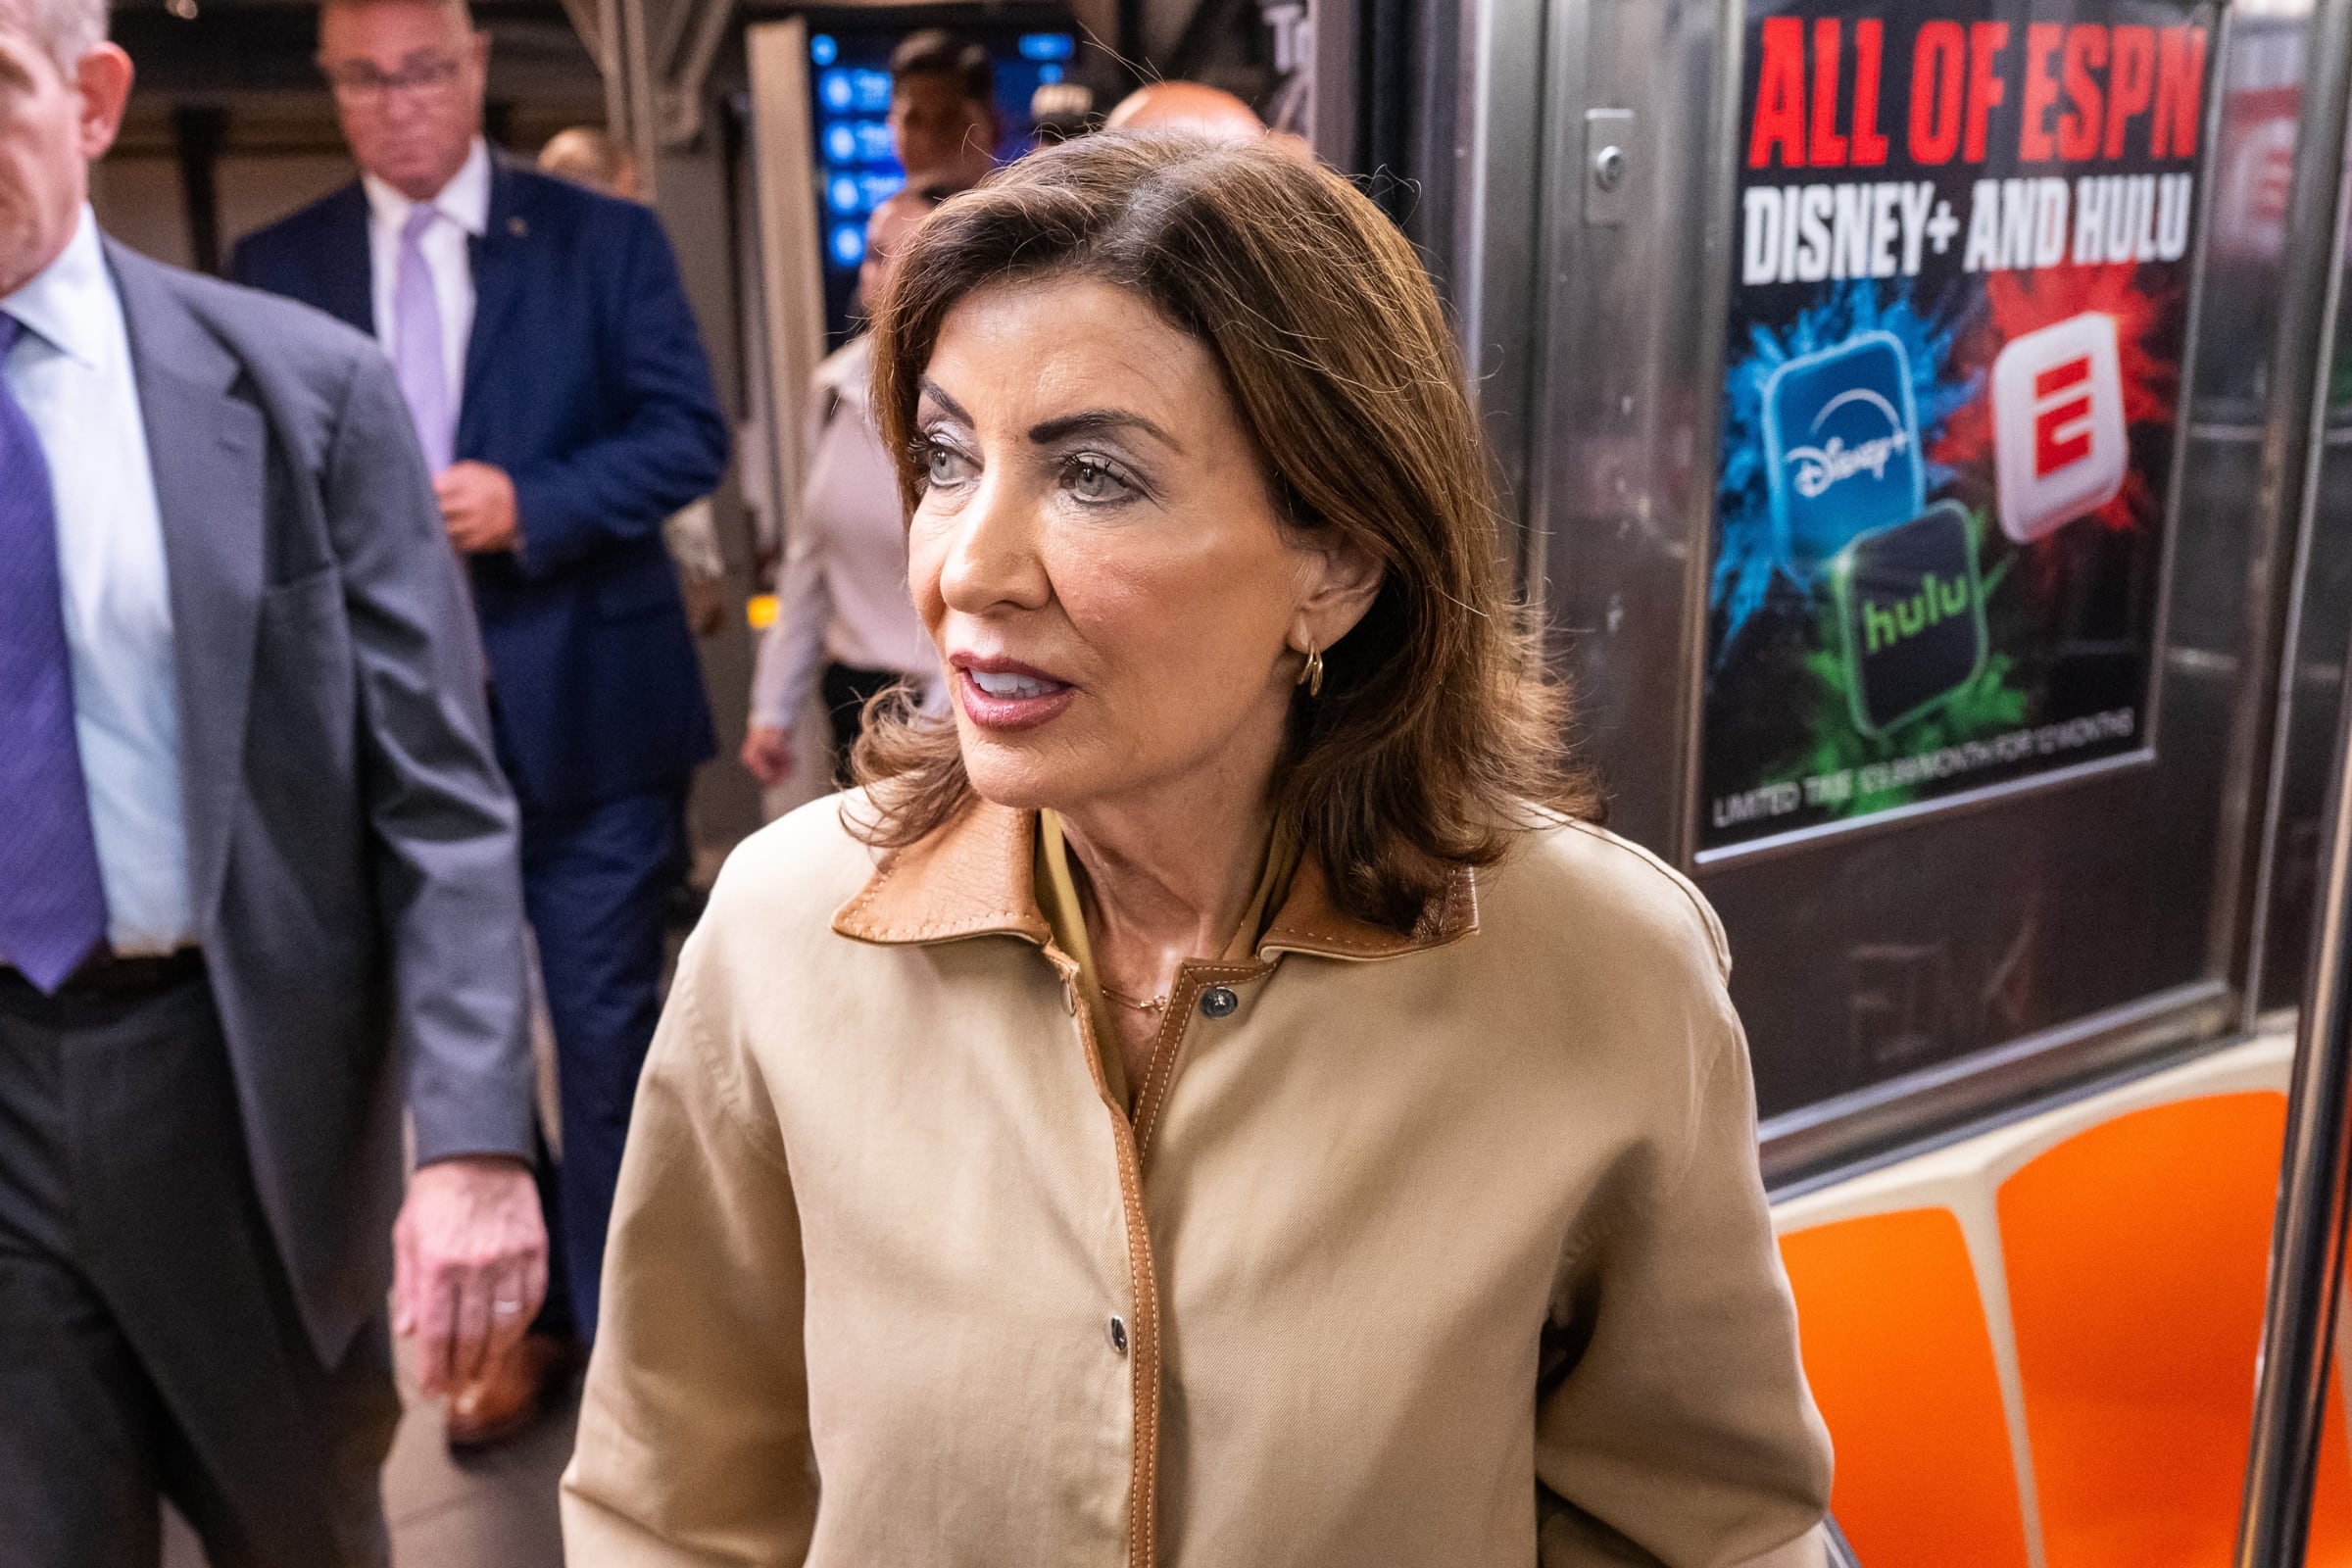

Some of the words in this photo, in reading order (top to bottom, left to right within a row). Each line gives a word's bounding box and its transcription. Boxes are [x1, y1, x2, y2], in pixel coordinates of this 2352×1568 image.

[1747, 16, 1888, 168] ALL
[1908, 20, 2009, 165] OF
[2019, 23, 2207, 162] ESPN
[1742, 180, 1959, 285] DISNEY+
[1962, 176, 2069, 273] AND
[2072, 172, 2194, 266] HULU
[1786, 426, 1908, 498] Disney+
[1864, 573, 1968, 652] hulu
[1713, 781, 1800, 827] LIMITED
